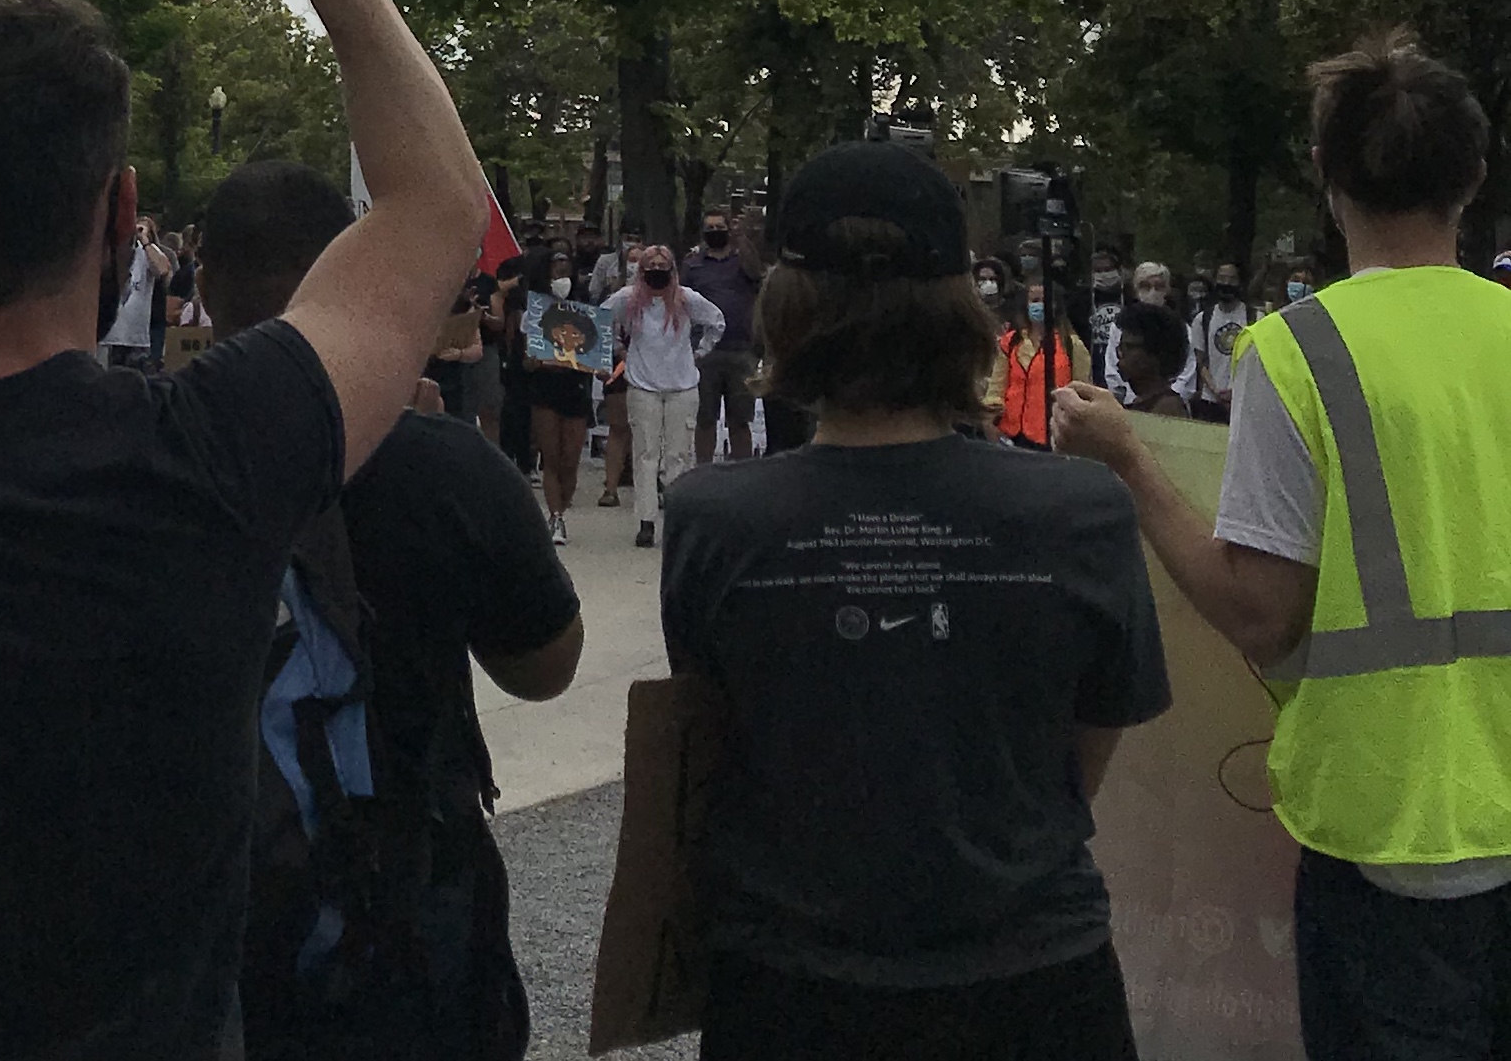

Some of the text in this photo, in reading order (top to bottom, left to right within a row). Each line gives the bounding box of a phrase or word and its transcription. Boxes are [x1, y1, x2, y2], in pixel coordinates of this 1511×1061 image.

[528, 297, 546, 352] BLACK
[557, 300, 597, 318] LIVES
[859, 525, 889, 535] Martin
[891, 525, 920, 535] Luther
[841, 538, 873, 547] Lincoln
[920, 537, 974, 548] Washington
